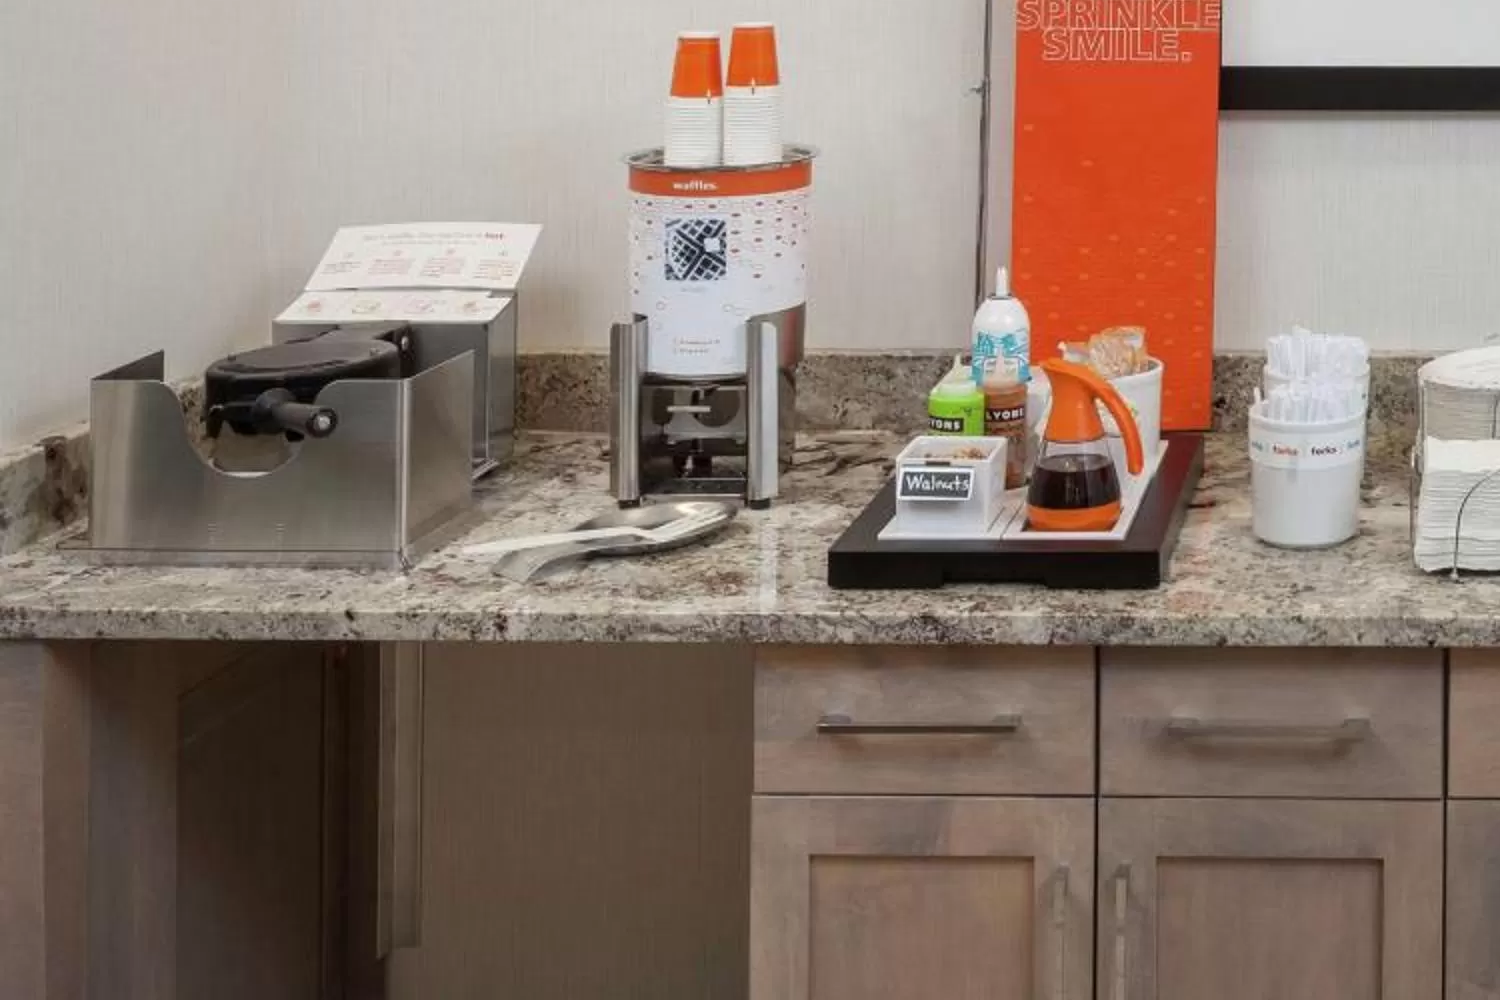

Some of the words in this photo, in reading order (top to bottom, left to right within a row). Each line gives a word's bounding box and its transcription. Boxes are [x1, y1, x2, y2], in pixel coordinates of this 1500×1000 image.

[1041, 27, 1192, 61] SMILE.
[928, 418, 960, 430] YONS
[905, 475, 969, 492] Walnuts
